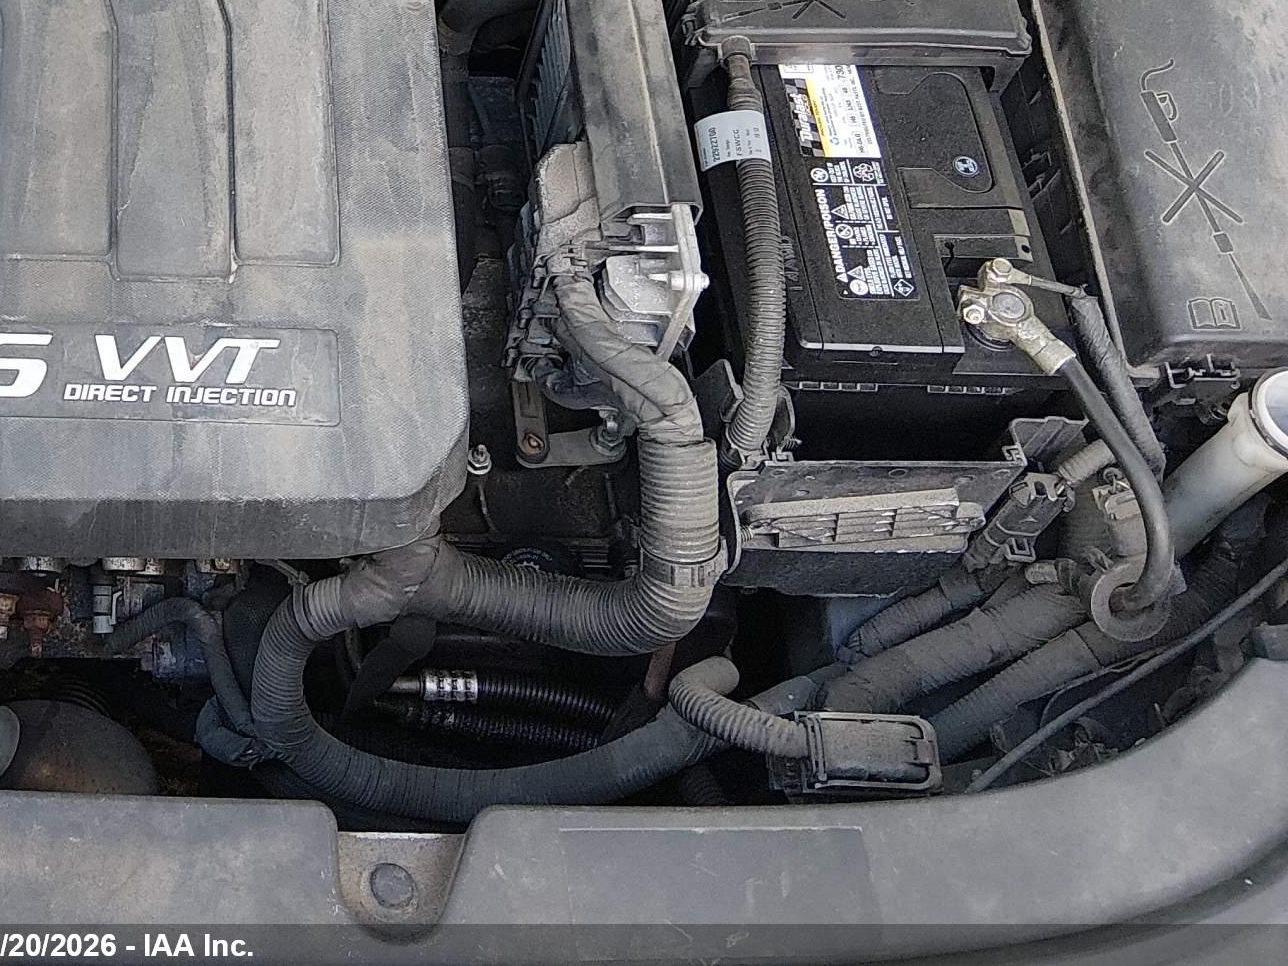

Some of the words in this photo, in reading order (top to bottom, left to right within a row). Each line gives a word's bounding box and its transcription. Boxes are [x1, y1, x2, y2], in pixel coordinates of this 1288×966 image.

[789, 93, 814, 142] Duralast
[814, 189, 846, 273] DANGER/POISON
[94, 335, 281, 384] VVT
[63, 384, 157, 403] DIRECT
[165, 386, 297, 407] INJECTION
